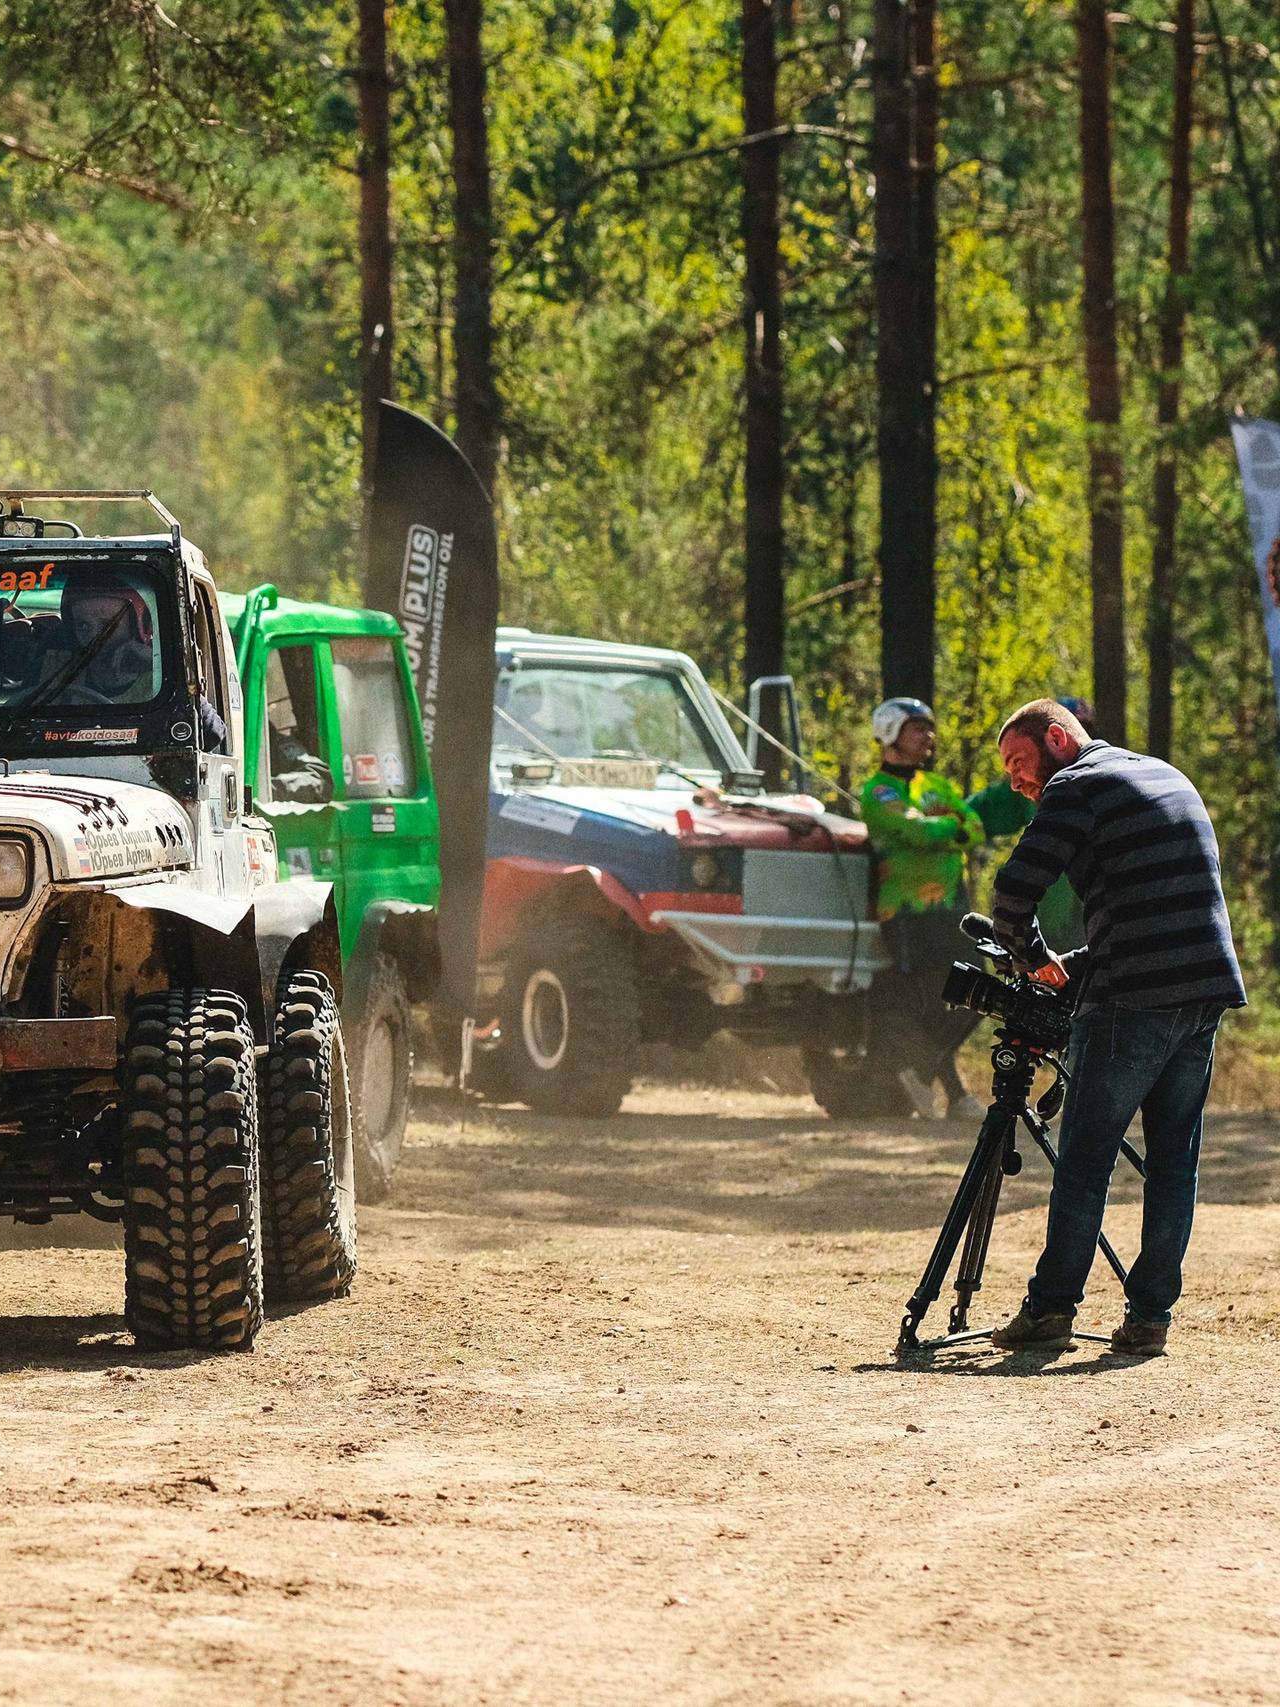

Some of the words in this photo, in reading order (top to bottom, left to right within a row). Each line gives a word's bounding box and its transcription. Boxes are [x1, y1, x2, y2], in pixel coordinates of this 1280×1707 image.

[403, 531, 435, 616] PLUS
[44, 728, 139, 742] #avtokotdosaaf
[90, 850, 124, 875] Юрьев
[126, 846, 153, 870] Артем
